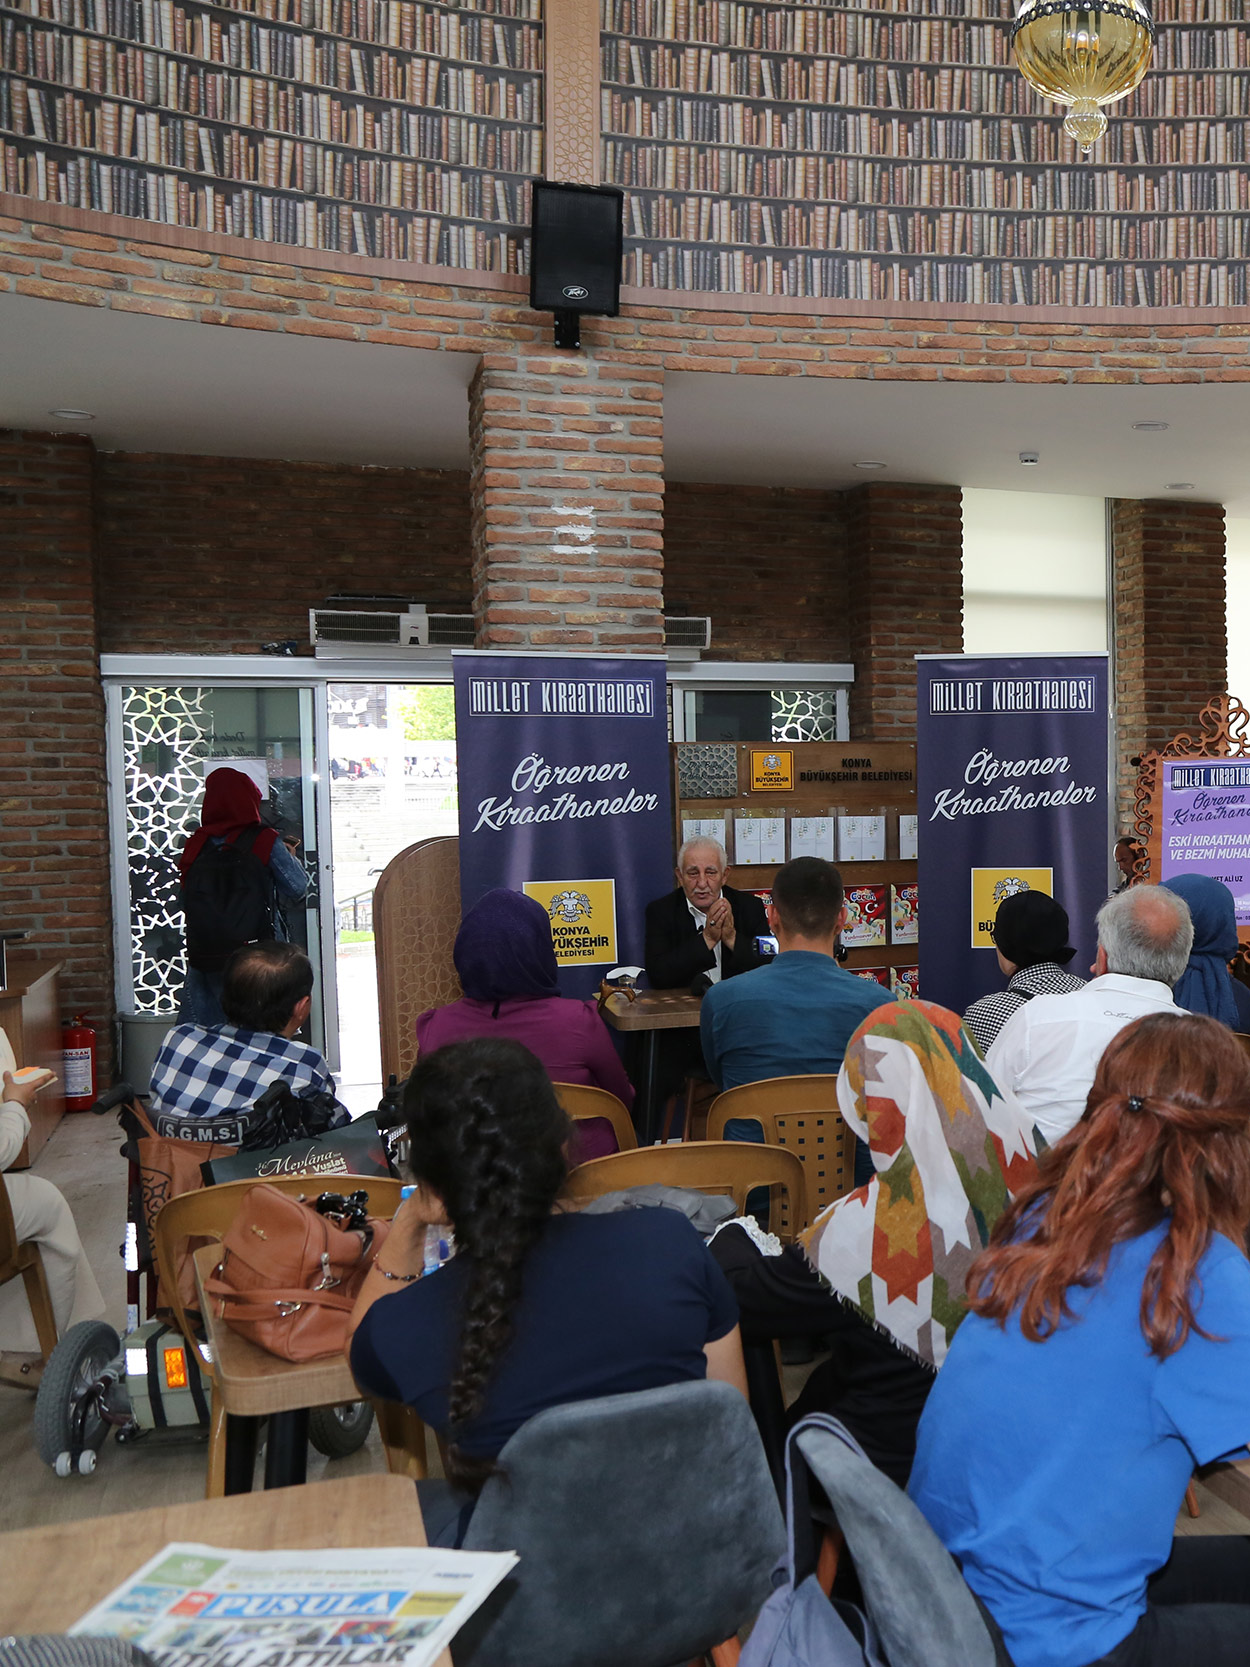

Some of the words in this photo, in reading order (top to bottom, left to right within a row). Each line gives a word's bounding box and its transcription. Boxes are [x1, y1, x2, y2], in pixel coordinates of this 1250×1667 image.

[841, 758, 872, 768] KONYA
[964, 748, 1071, 787] Öğrenen
[511, 752, 631, 794] Öğrenen
[800, 769, 859, 784] BÜYÜKŞEHİR
[861, 769, 913, 781] BELEDİYESİ
[929, 781, 1097, 822] Kıraathaneler
[472, 788, 659, 833] Kıraathaneler
[1168, 833, 1192, 847] ESKİ
[1170, 849, 1184, 860] VE
[1184, 846, 1217, 860] BEZMİ
[1224, 875, 1234, 883] ALİ
[552, 926, 591, 936] KONYA
[552, 934, 609, 949] YÜKŞEHİR
[555, 948, 595, 957] ELEDİYESİ
[165, 1123, 236, 1142] S.G.M.S.
[258, 1145, 333, 1177] Mevlâna
[312, 1157, 346, 1172] Vuslat
[212, 1593, 390, 1616] PUSULA
